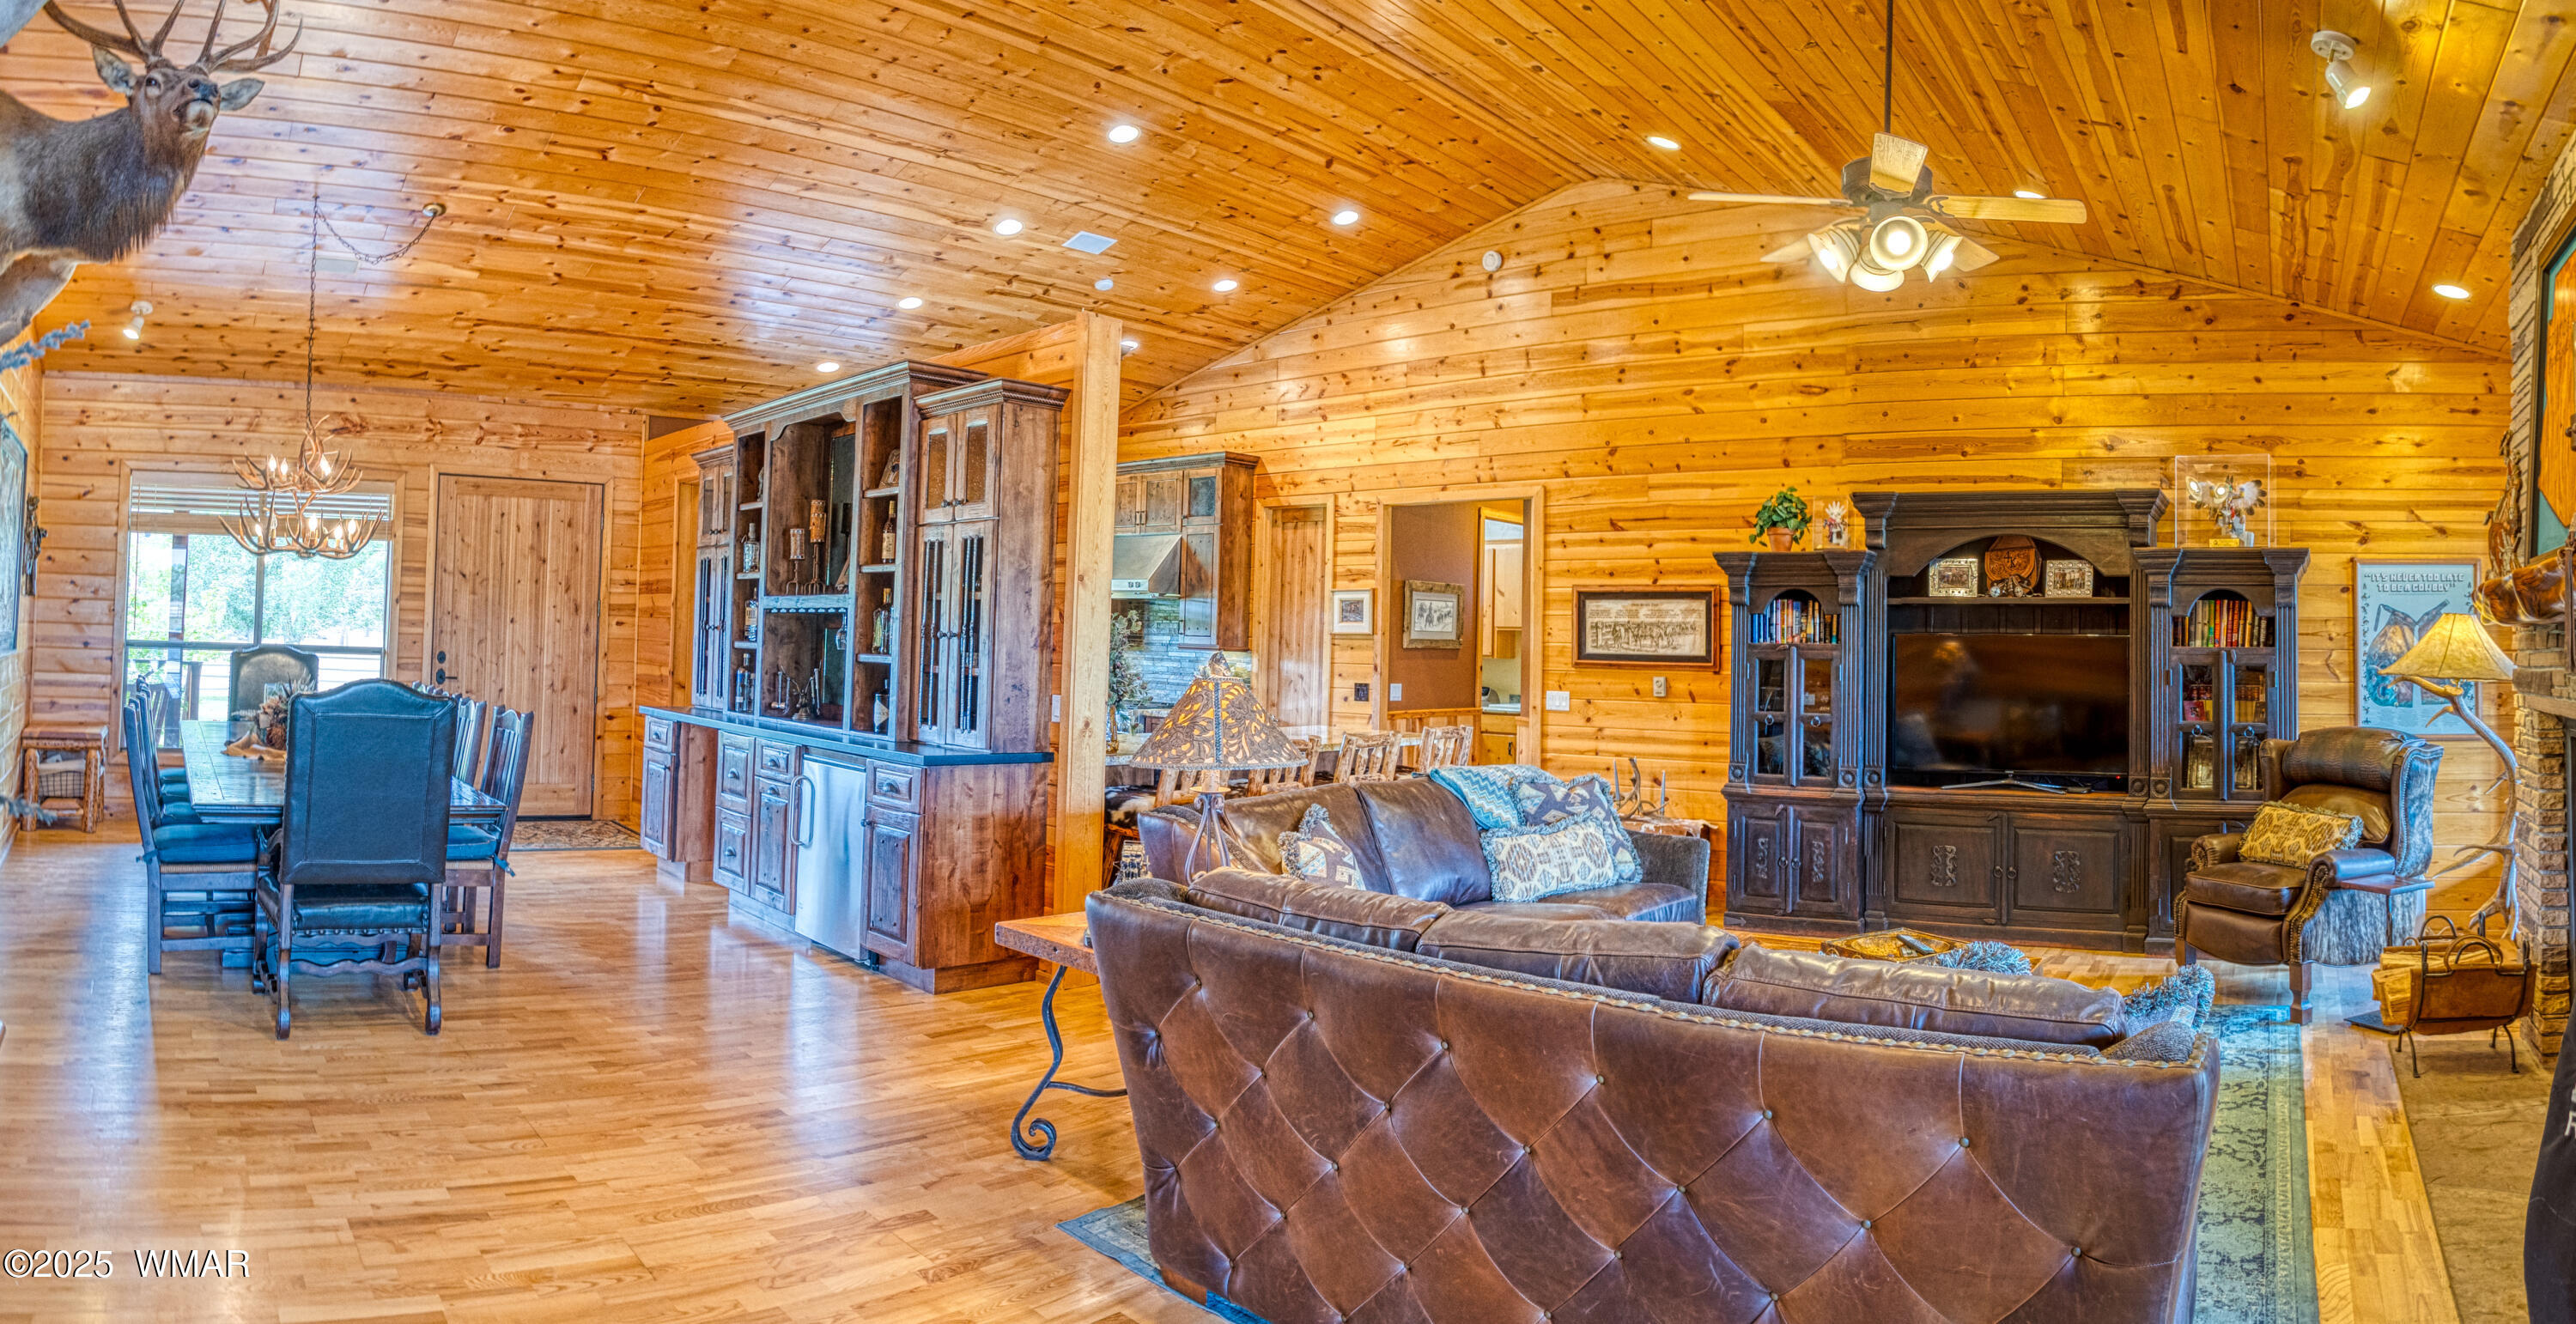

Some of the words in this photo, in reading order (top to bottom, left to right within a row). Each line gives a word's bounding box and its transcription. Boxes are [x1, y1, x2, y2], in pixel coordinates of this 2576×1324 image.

[2390, 573, 2421, 582] NEVER
[2421, 573, 2440, 582] TOO
[2441, 573, 2464, 582] LATE
[2378, 583, 2389, 592] TO
[2390, 583, 2404, 592] BE
[2404, 583, 2412, 592] A
